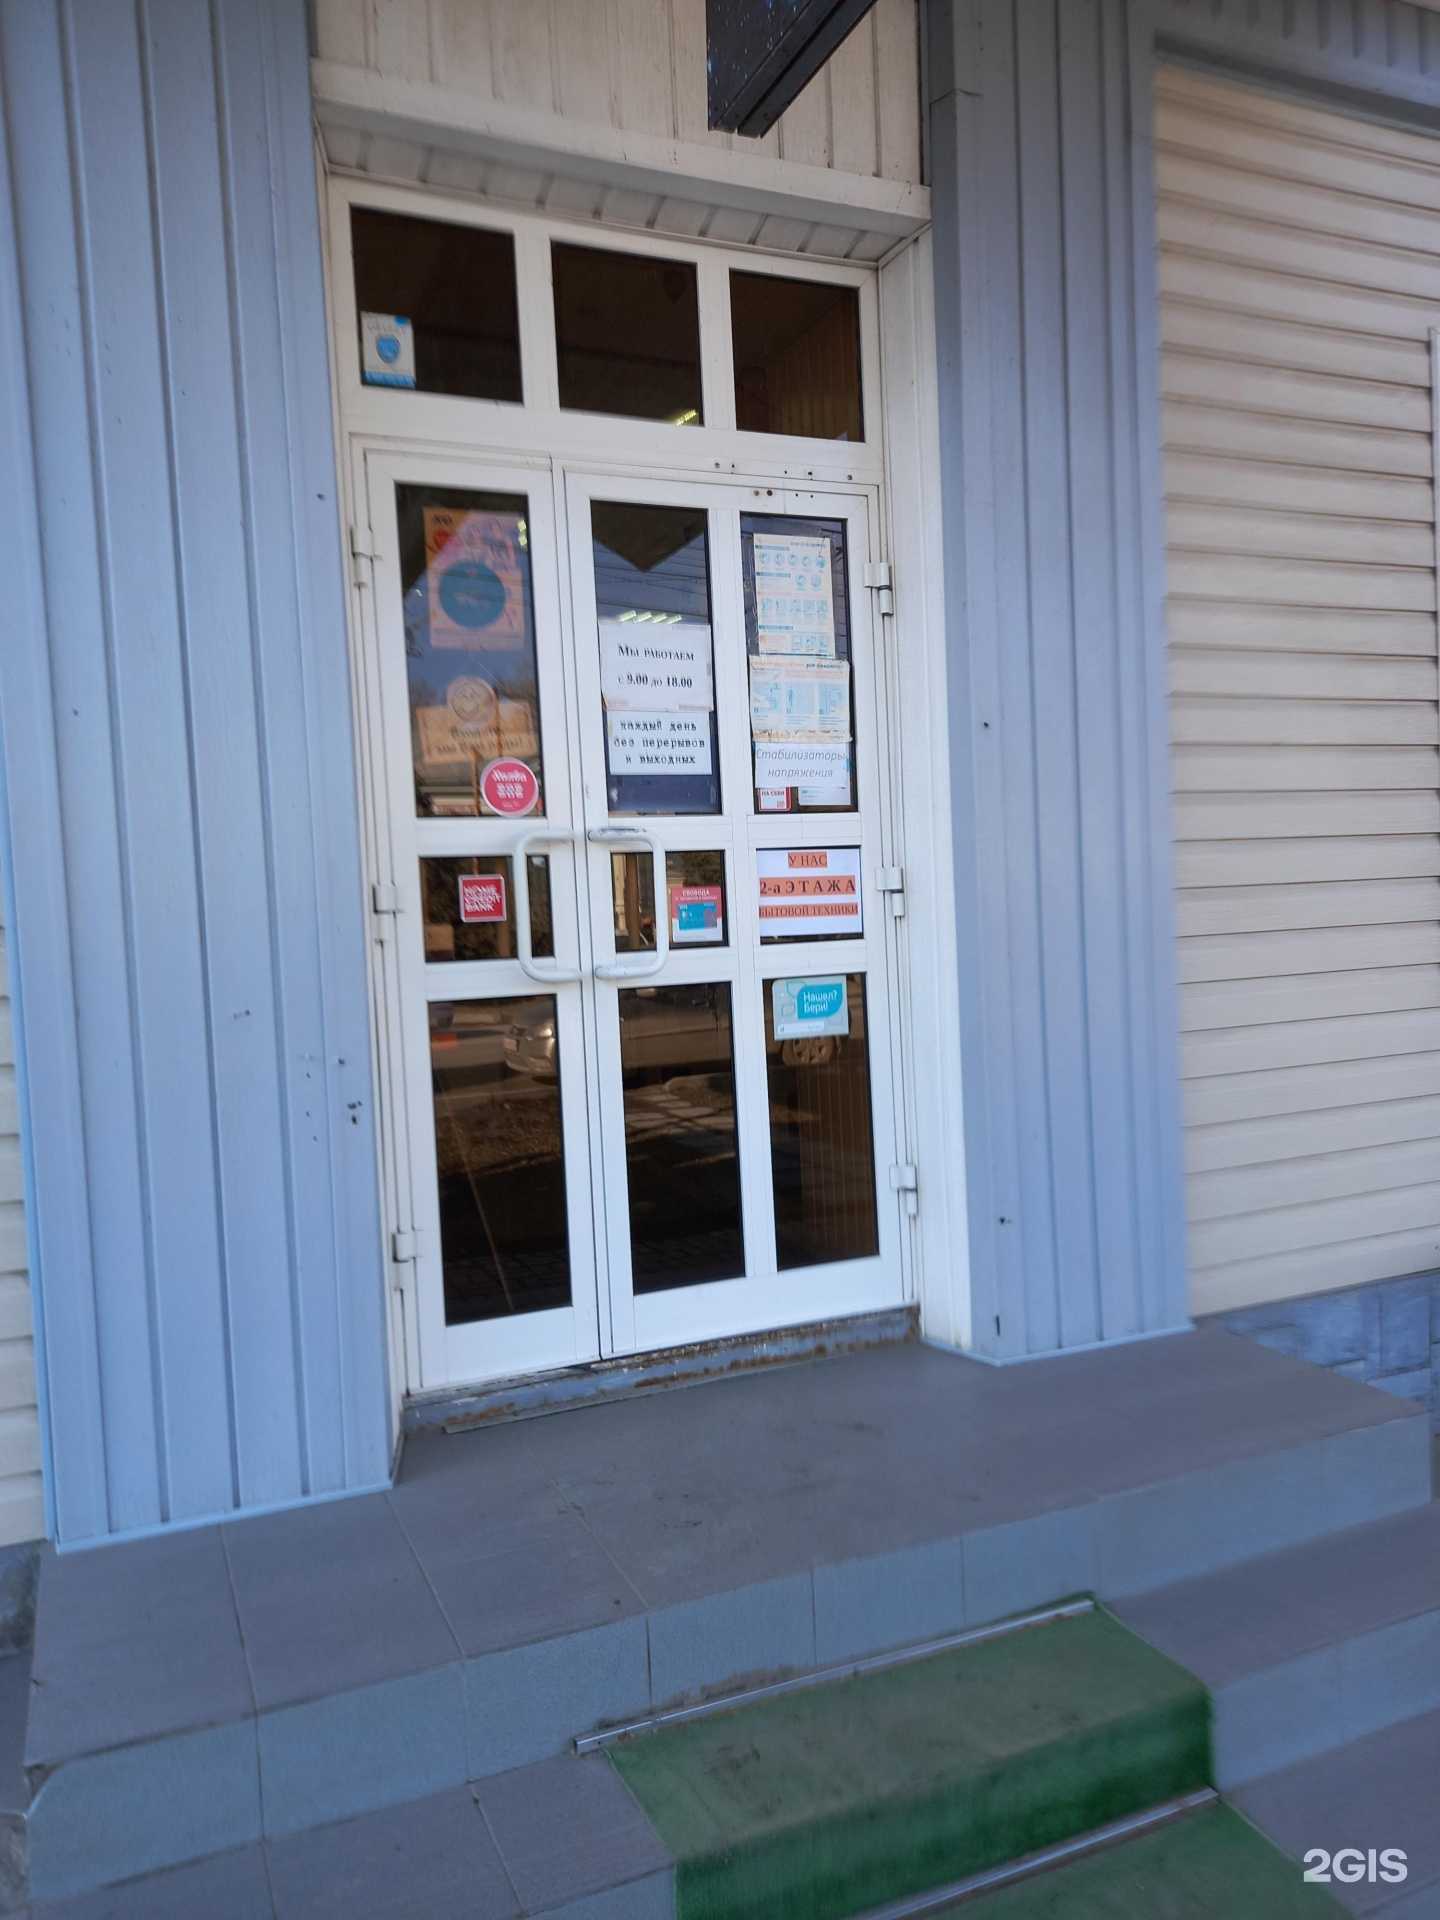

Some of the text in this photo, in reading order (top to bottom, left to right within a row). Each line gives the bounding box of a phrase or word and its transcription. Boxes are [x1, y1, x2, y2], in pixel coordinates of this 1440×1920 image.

[627, 673, 649, 685] 9.00
[651, 679, 663, 688] до
[666, 676, 693, 688] 18.00
[620, 719, 697, 732] каждый день
[614, 738, 705, 750] без перерывов
[639, 755, 696, 765] выходных
[767, 767, 833, 779] напряжения
[789, 855, 827, 866] У НАС
